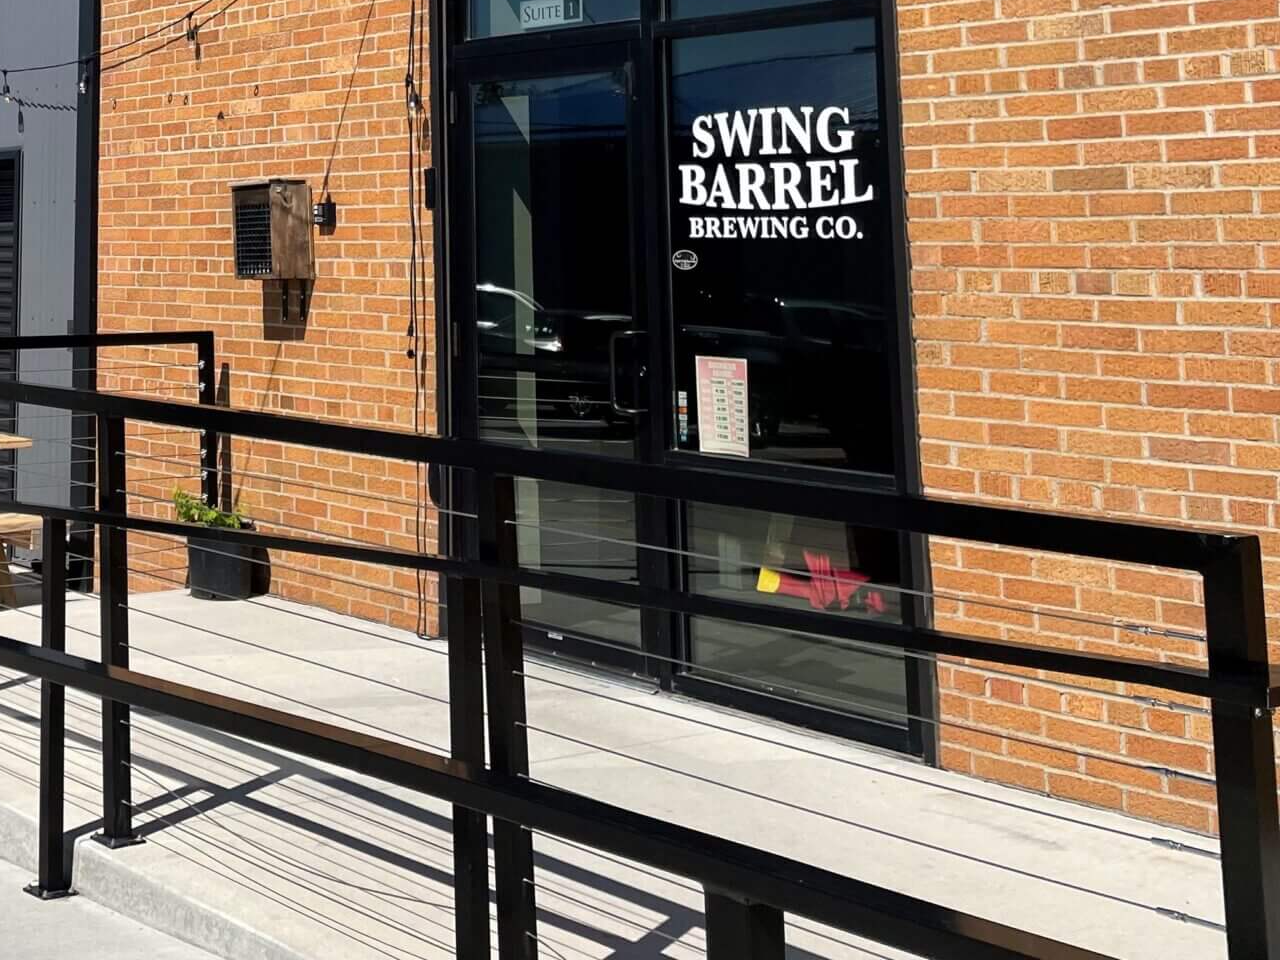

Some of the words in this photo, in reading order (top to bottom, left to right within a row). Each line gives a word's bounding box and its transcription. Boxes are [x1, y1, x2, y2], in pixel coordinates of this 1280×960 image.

[692, 106, 855, 159] SWING
[678, 158, 874, 210] BARREL
[689, 216, 810, 239] BREWING
[815, 216, 864, 239] CO.
